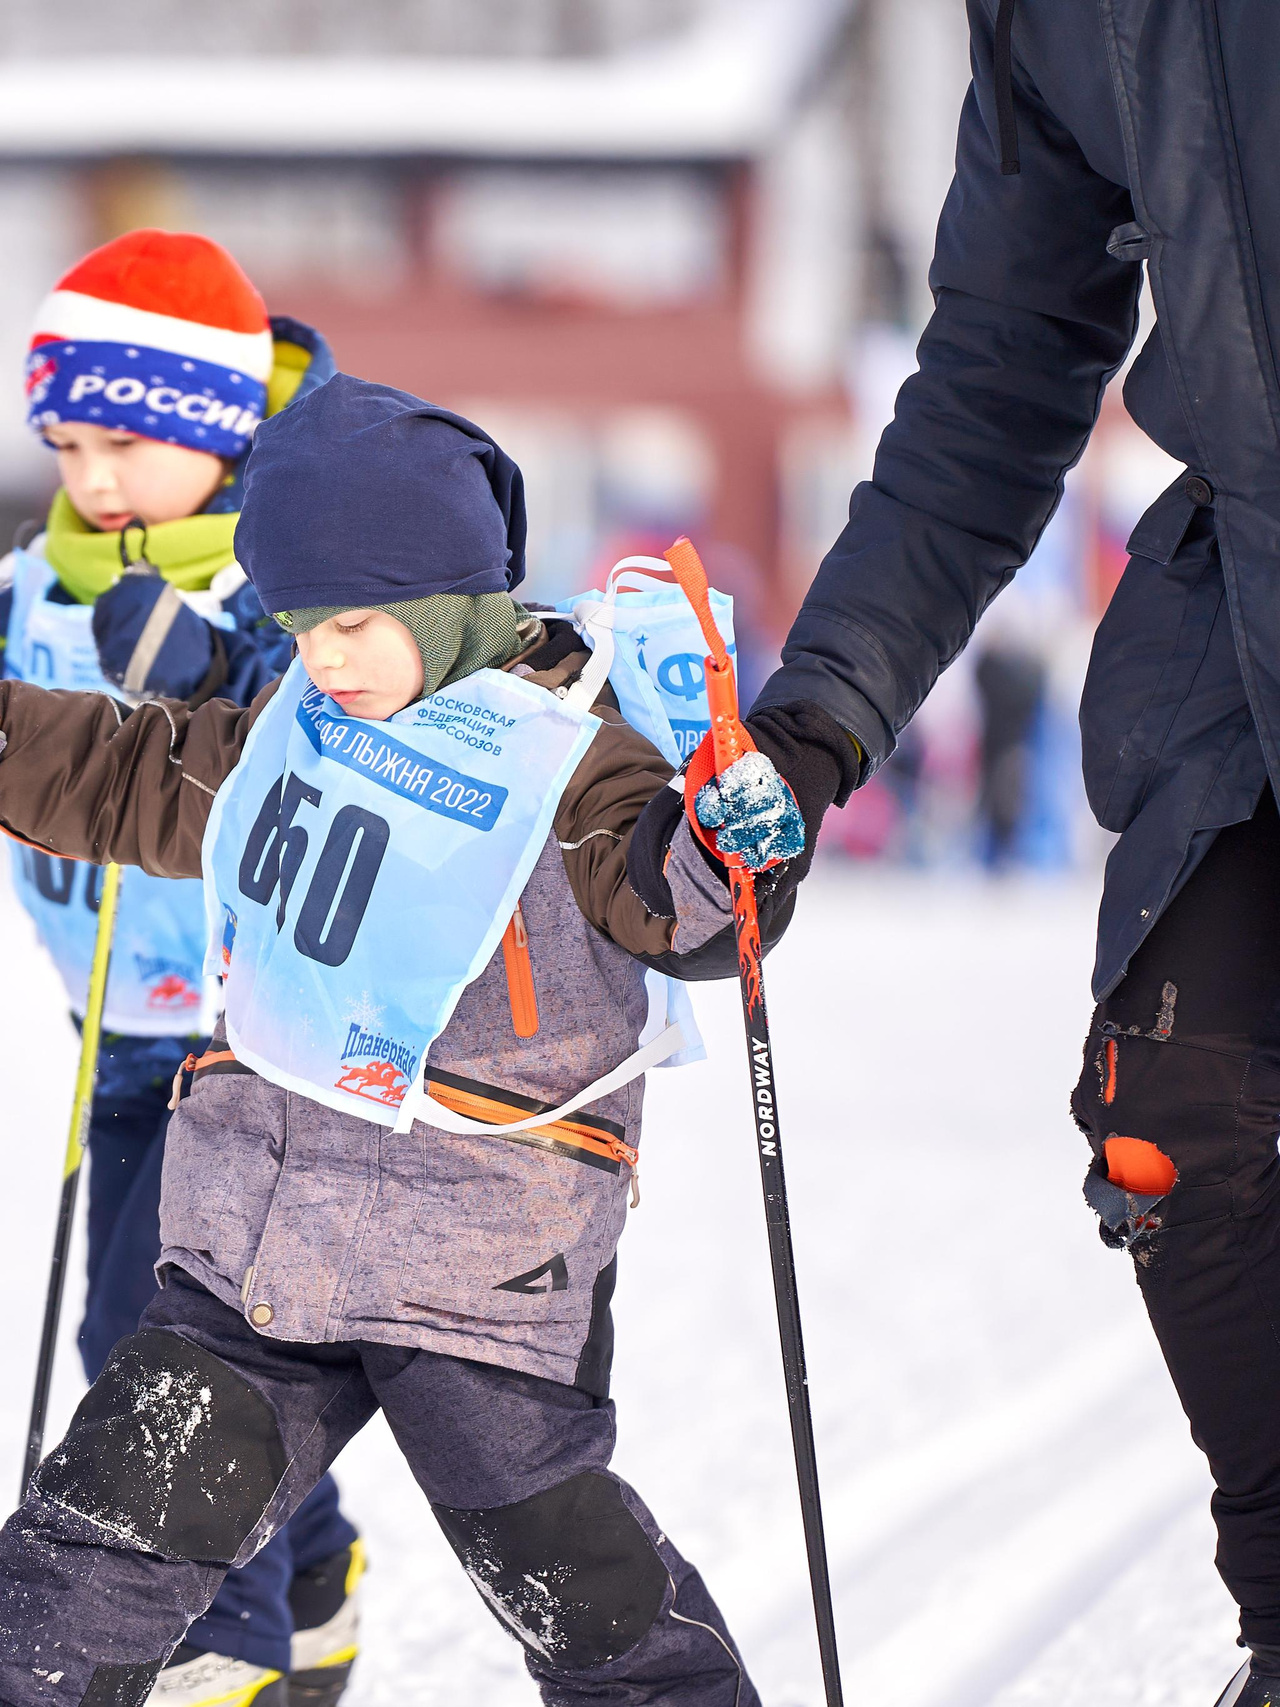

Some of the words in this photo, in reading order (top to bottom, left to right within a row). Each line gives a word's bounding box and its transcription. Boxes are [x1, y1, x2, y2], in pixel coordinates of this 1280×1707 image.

[417, 707, 496, 737] ФЕДЕРАЦИЯ
[342, 731, 435, 796] ЛЫЖНЯ
[429, 776, 493, 818] 2022
[340, 1022, 417, 1085] Планерная
[751, 1037, 777, 1157] NORDWAY
